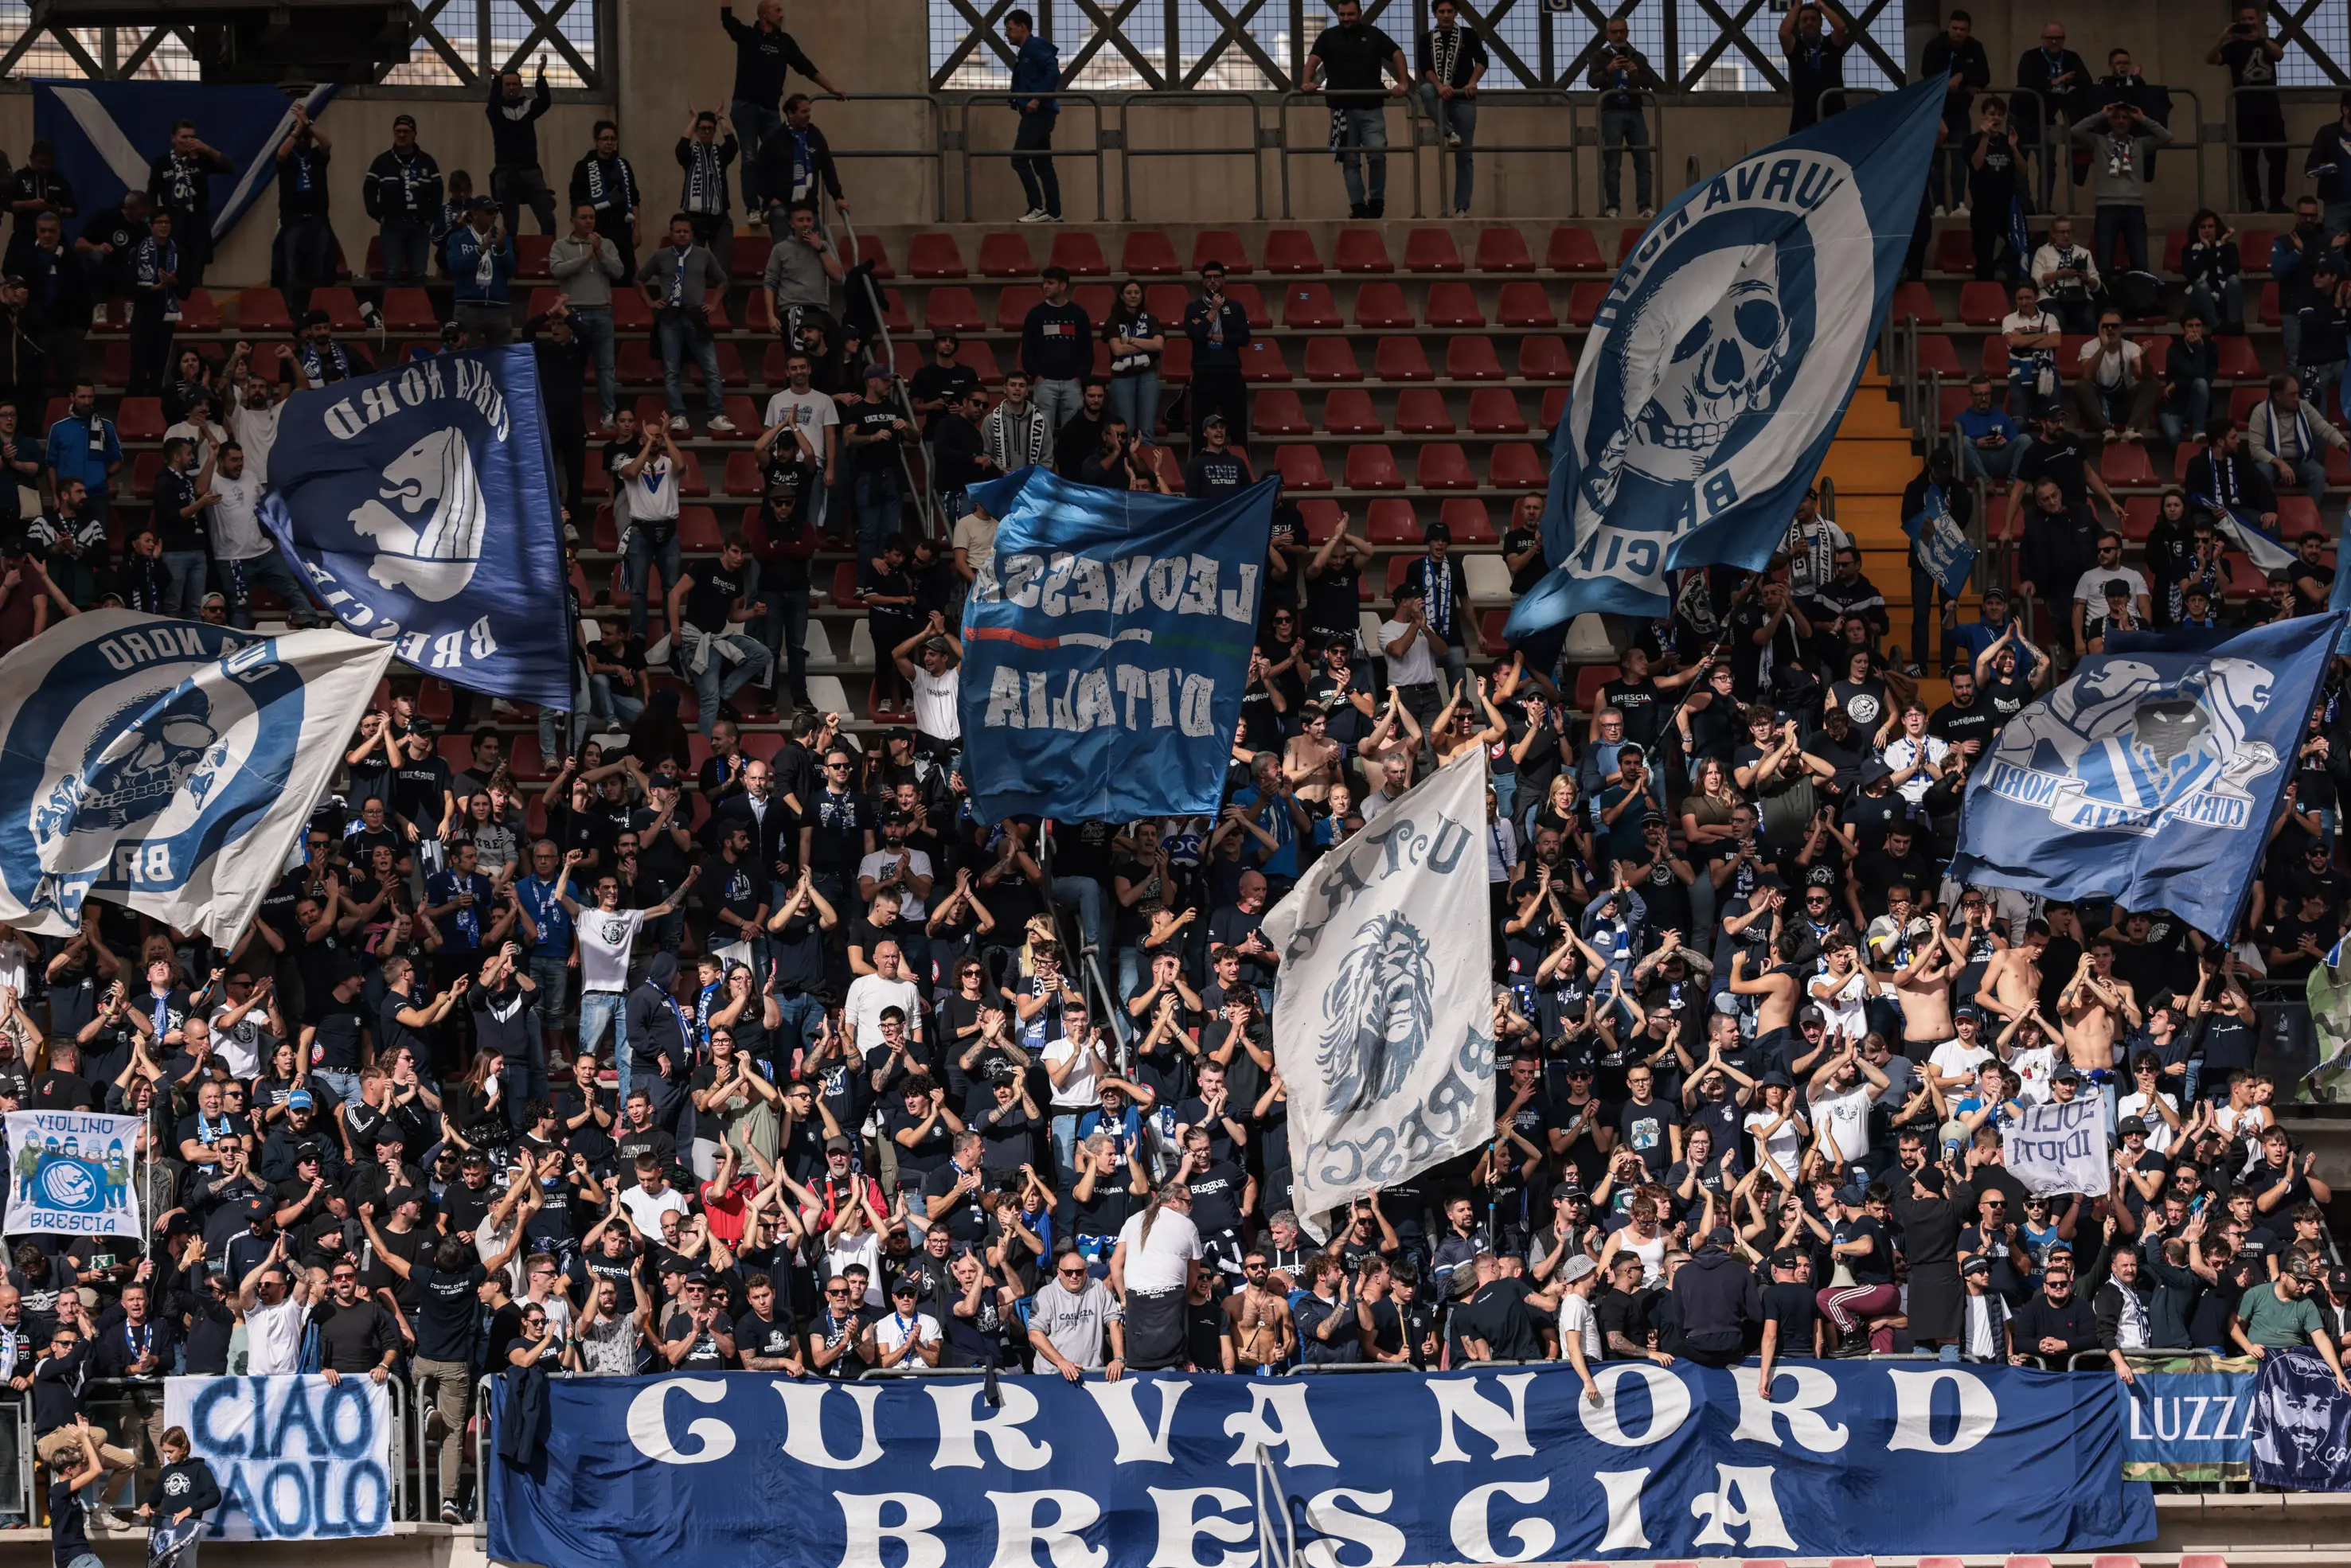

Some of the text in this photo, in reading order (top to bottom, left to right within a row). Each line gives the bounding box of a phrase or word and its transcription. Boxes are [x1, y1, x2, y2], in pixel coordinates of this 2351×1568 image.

[713, 575, 736, 592] Brescia
[1611, 695, 1652, 704] BRESCIA
[1994, 697, 2020, 709] BRESCIA
[36, 1114, 114, 1134] VIOLINO
[1190, 1179, 1228, 1194] BARBARI
[30, 1212, 115, 1232] BRESCIA
[592, 1266, 630, 1277] Brescia
[193, 1375, 372, 1459] CIAO
[627, 1363, 1998, 1471] CURVA NORD
[205, 1459, 388, 1539] AOLO
[833, 1462, 1798, 1568] BRESCIA
